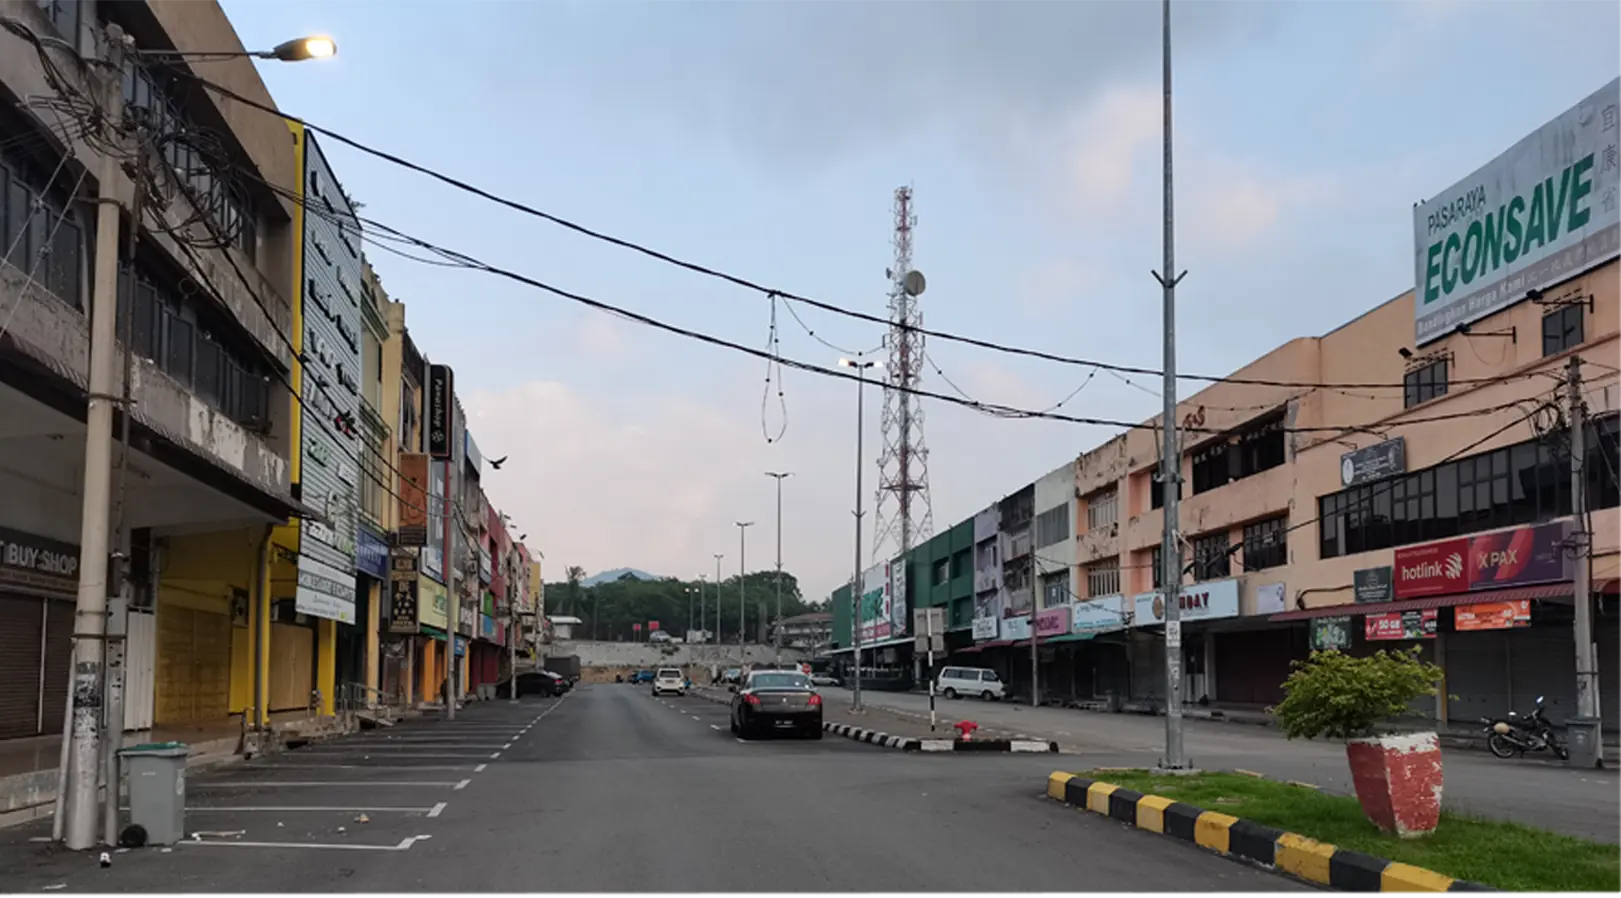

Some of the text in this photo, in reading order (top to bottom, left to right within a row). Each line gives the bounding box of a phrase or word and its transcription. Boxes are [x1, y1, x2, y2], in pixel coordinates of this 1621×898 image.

[1424, 152, 1595, 304] ECONSAVE
[1427, 184, 1486, 236] PASARAYA
[6, 542, 39, 568] BUY
[38, 549, 78, 577] SHOP
[1401, 561, 1443, 581] hotlink
